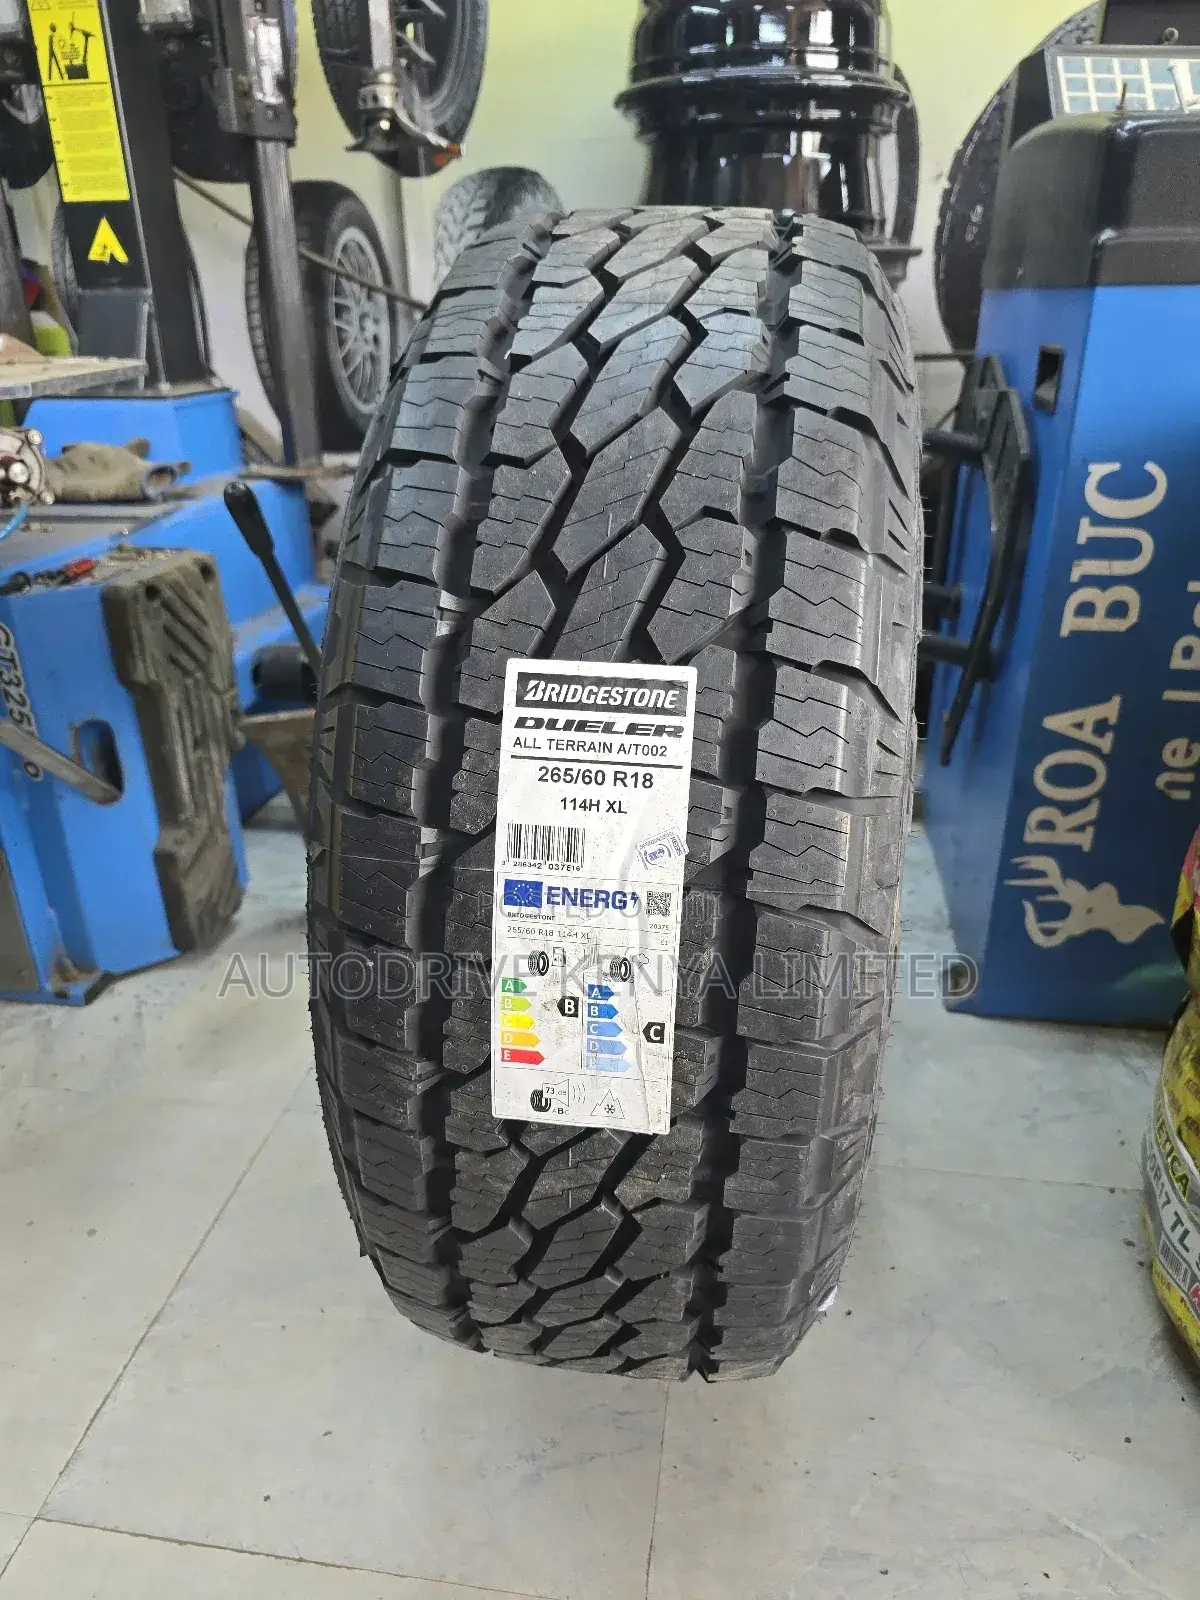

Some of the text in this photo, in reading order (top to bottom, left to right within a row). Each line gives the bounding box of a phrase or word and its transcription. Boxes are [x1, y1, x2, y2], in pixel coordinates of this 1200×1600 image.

[1023, 460, 1168, 853] ROA BUC
[523, 679, 680, 709] BRIDGESTONE
[513, 716, 685, 739] DUELER
[513, 736, 668, 757] ALL TERRAIN A/T002
[537, 766, 654, 789] 265/60 R18
[560, 797, 628, 814] 114H XL
[538, 928, 554, 937] R18
[504, 979, 515, 991] A
[591, 987, 602, 999] A
[504, 998, 513, 1009] B
[564, 998, 575, 1015] B
[590, 1005, 599, 1016] B
[589, 1023, 599, 1034] C
[649, 1025, 661, 1041] C
[589, 1041, 599, 1051] D
[503, 1049, 511, 1061] E
[545, 1087, 555, 1095] 73
[1169, 1209, 1191, 1254] TL
